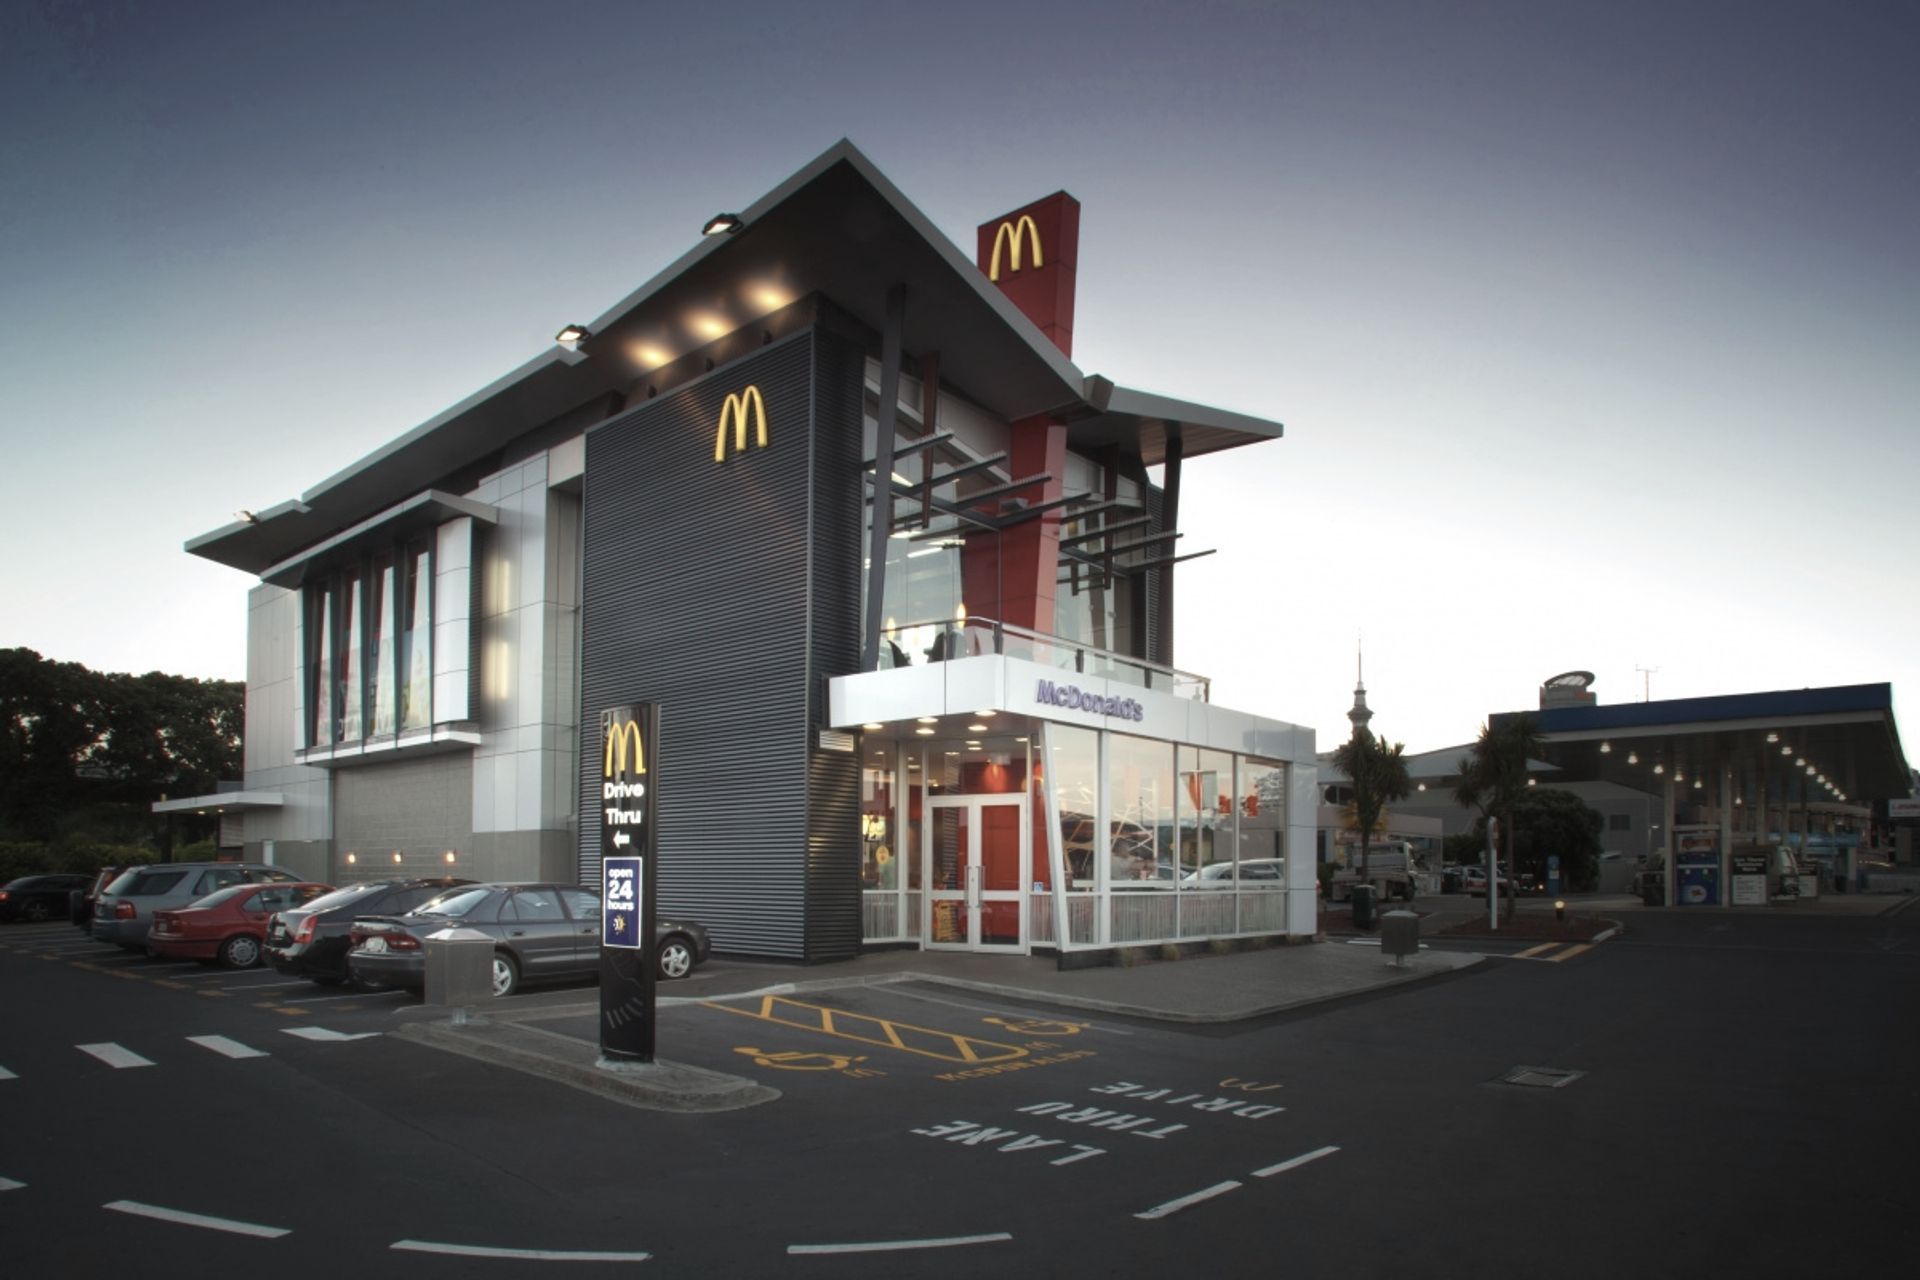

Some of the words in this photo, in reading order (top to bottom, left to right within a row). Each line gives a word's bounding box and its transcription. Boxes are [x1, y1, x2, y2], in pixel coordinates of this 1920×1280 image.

[1036, 678, 1143, 722] McDonald's
[604, 781, 644, 799] Drive
[605, 807, 641, 825] Thru
[608, 868, 633, 880] open
[608, 879, 633, 900] 24
[608, 899, 634, 911] hours
[1088, 1081, 1287, 1119] DRIVE
[1015, 1101, 1189, 1139] THRU
[909, 1120, 1108, 1166] LANE
